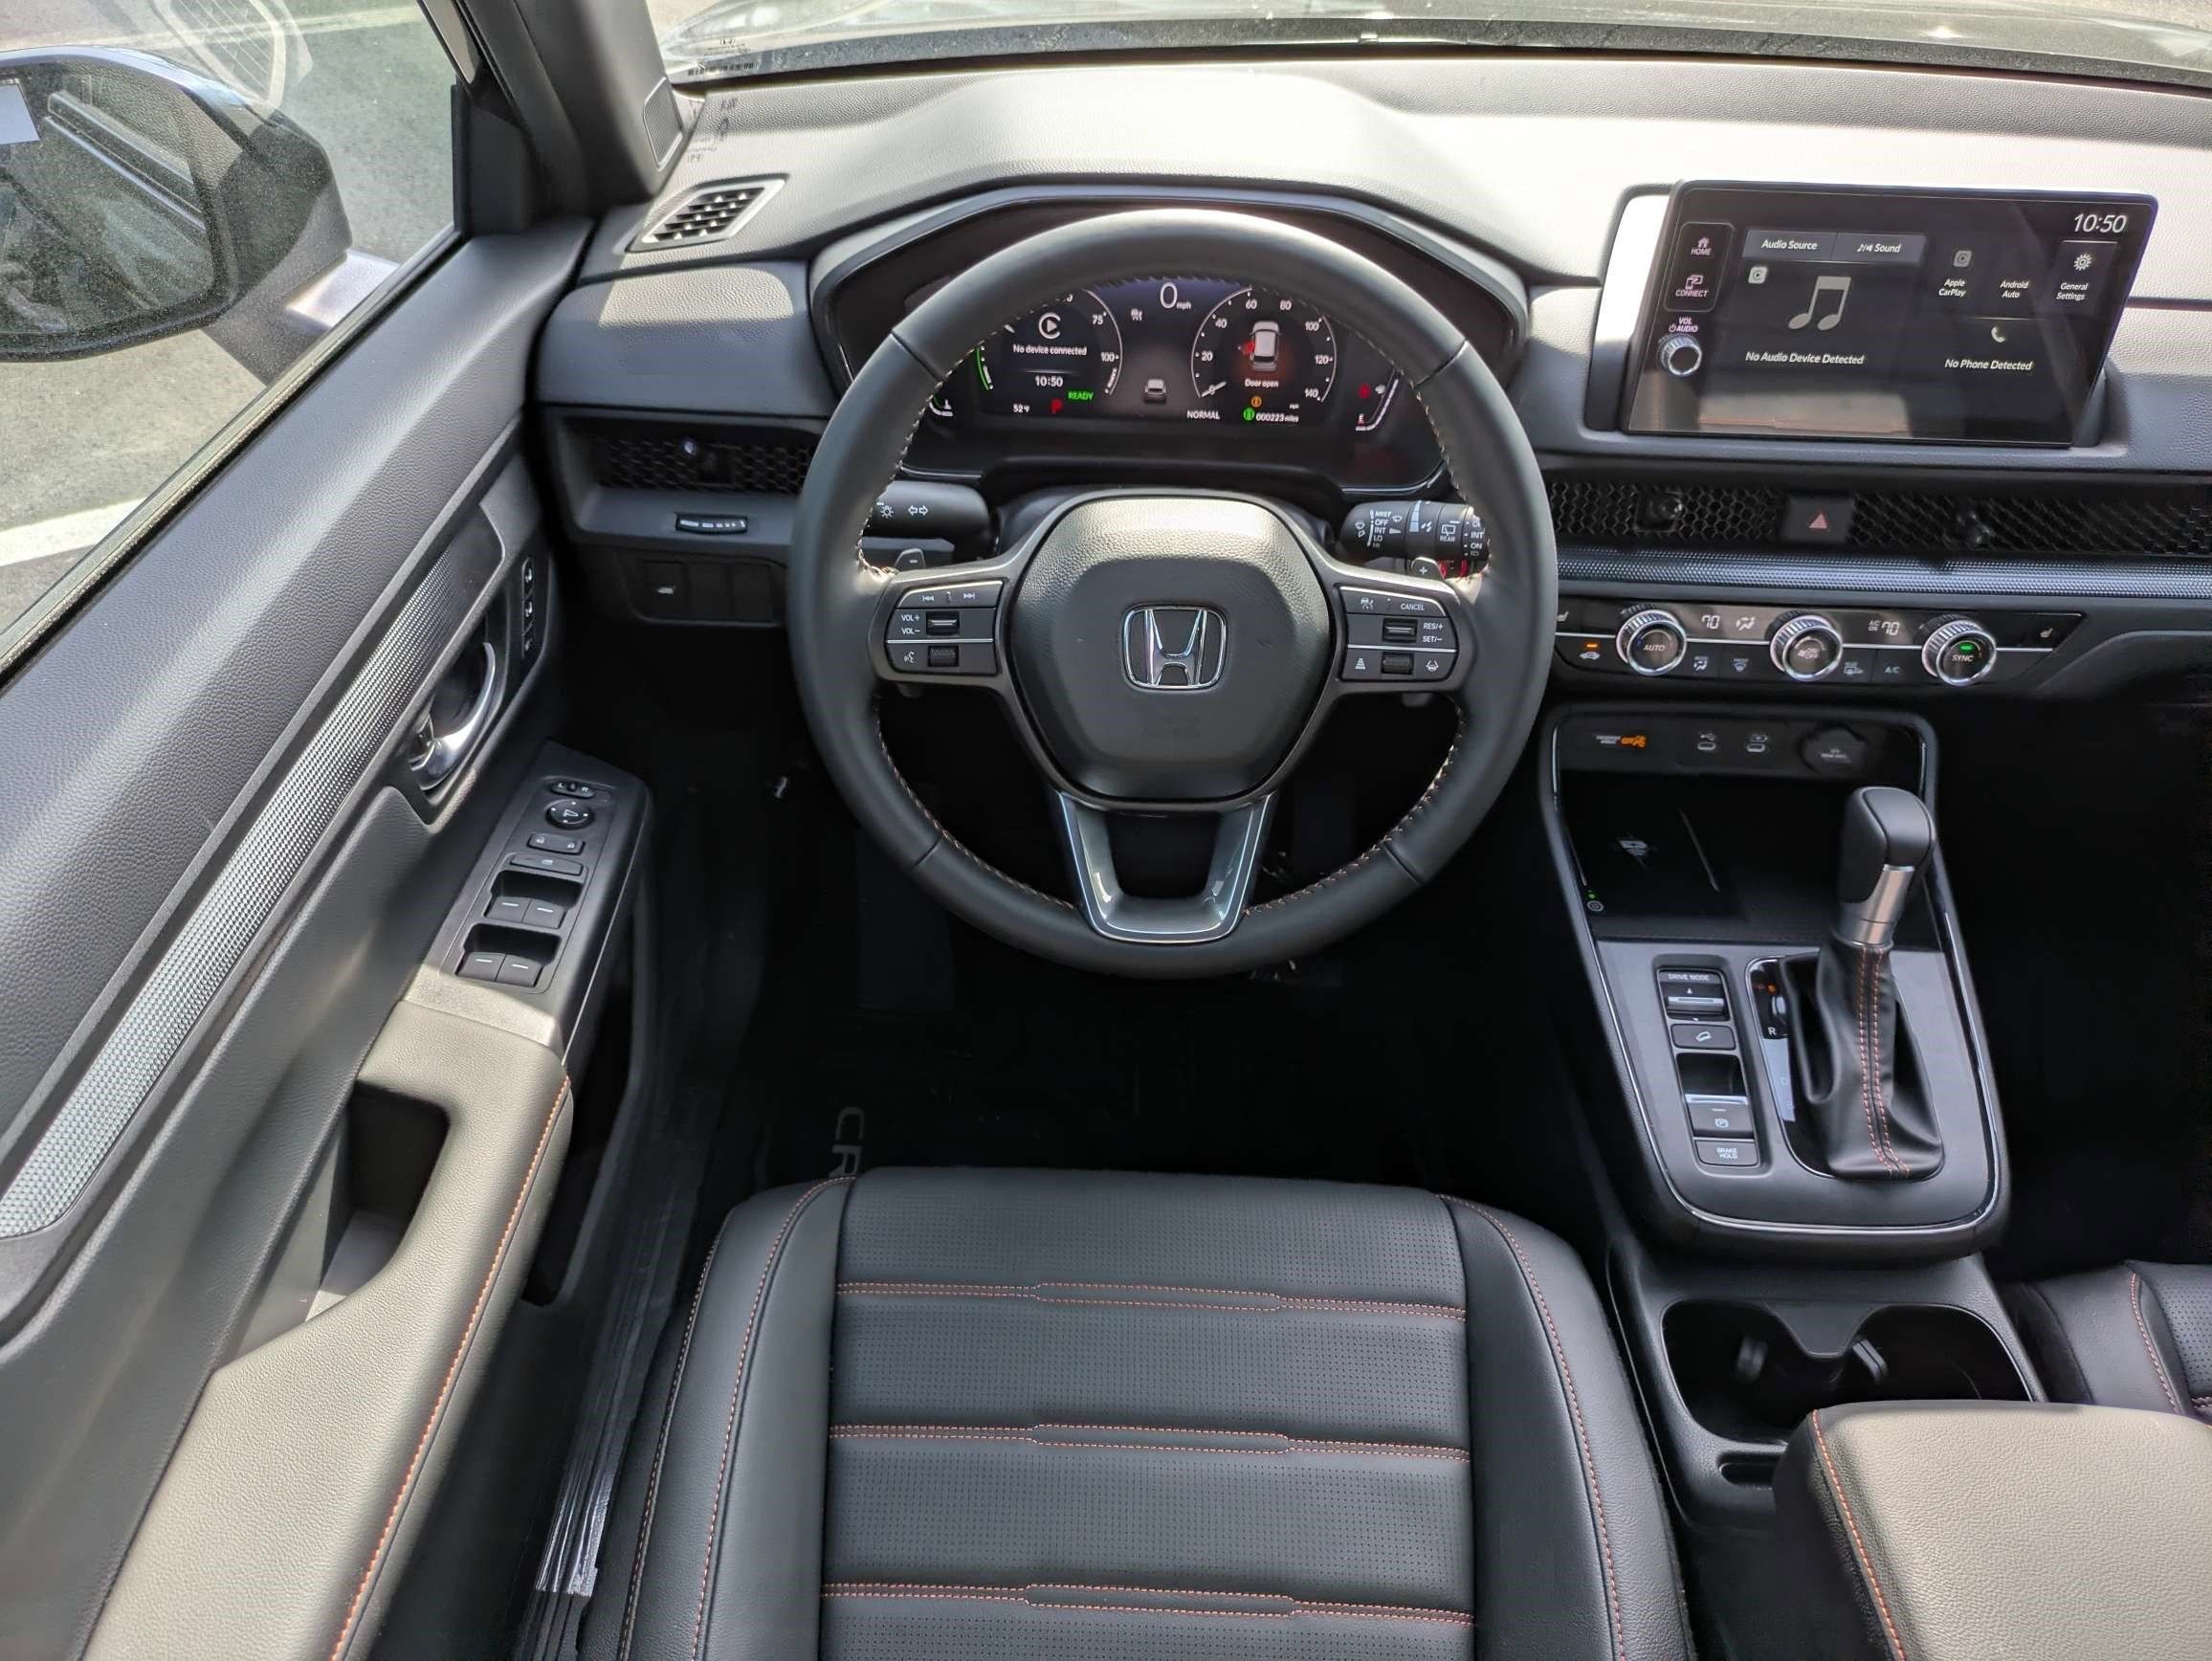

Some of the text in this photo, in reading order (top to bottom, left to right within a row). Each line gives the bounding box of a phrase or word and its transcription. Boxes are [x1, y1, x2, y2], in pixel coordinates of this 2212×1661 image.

[2074, 214, 2127, 233] 10:50
[1761, 239, 1818, 251] Audio Source
[1874, 244, 1901, 253] Sound
[1944, 278, 1966, 288] Apple
[2000, 280, 2028, 289] Android
[2060, 282, 2089, 291] General
[1160, 282, 1178, 309] 0
[1675, 289, 1709, 298] CONNECT
[1938, 288, 1966, 298] CarPlay
[2056, 292, 2086, 301] Settings
[1245, 299, 1258, 310] 60
[1279, 299, 1292, 311] 80
[1092, 314, 1104, 325] 75
[1215, 318, 1228, 329] 40
[1304, 321, 1319, 332] 100
[1676, 324, 1698, 333] AUDIO
[1012, 344, 1087, 356] No device connected
[1100, 352, 1116, 363] 100
[1201, 351, 1213, 362] 20
[1315, 354, 1329, 365] 120
[1745, 352, 1865, 365] No Audio Device Detected
[1945, 359, 2033, 371] No Phone Detected
[1035, 376, 1064, 388] 10:50
[1245, 379, 1279, 388] Door open
[1068, 391, 1095, 401] READY
[1304, 388, 1319, 398] 140
[1186, 410, 1221, 420] NORMAL
[1255, 412, 1285, 422] 000223
[1375, 510, 1392, 519] MIST
[1701, 615, 1720, 630] 70
[1881, 621, 1900, 636] 70
[1951, 654, 1974, 663] SYNC
